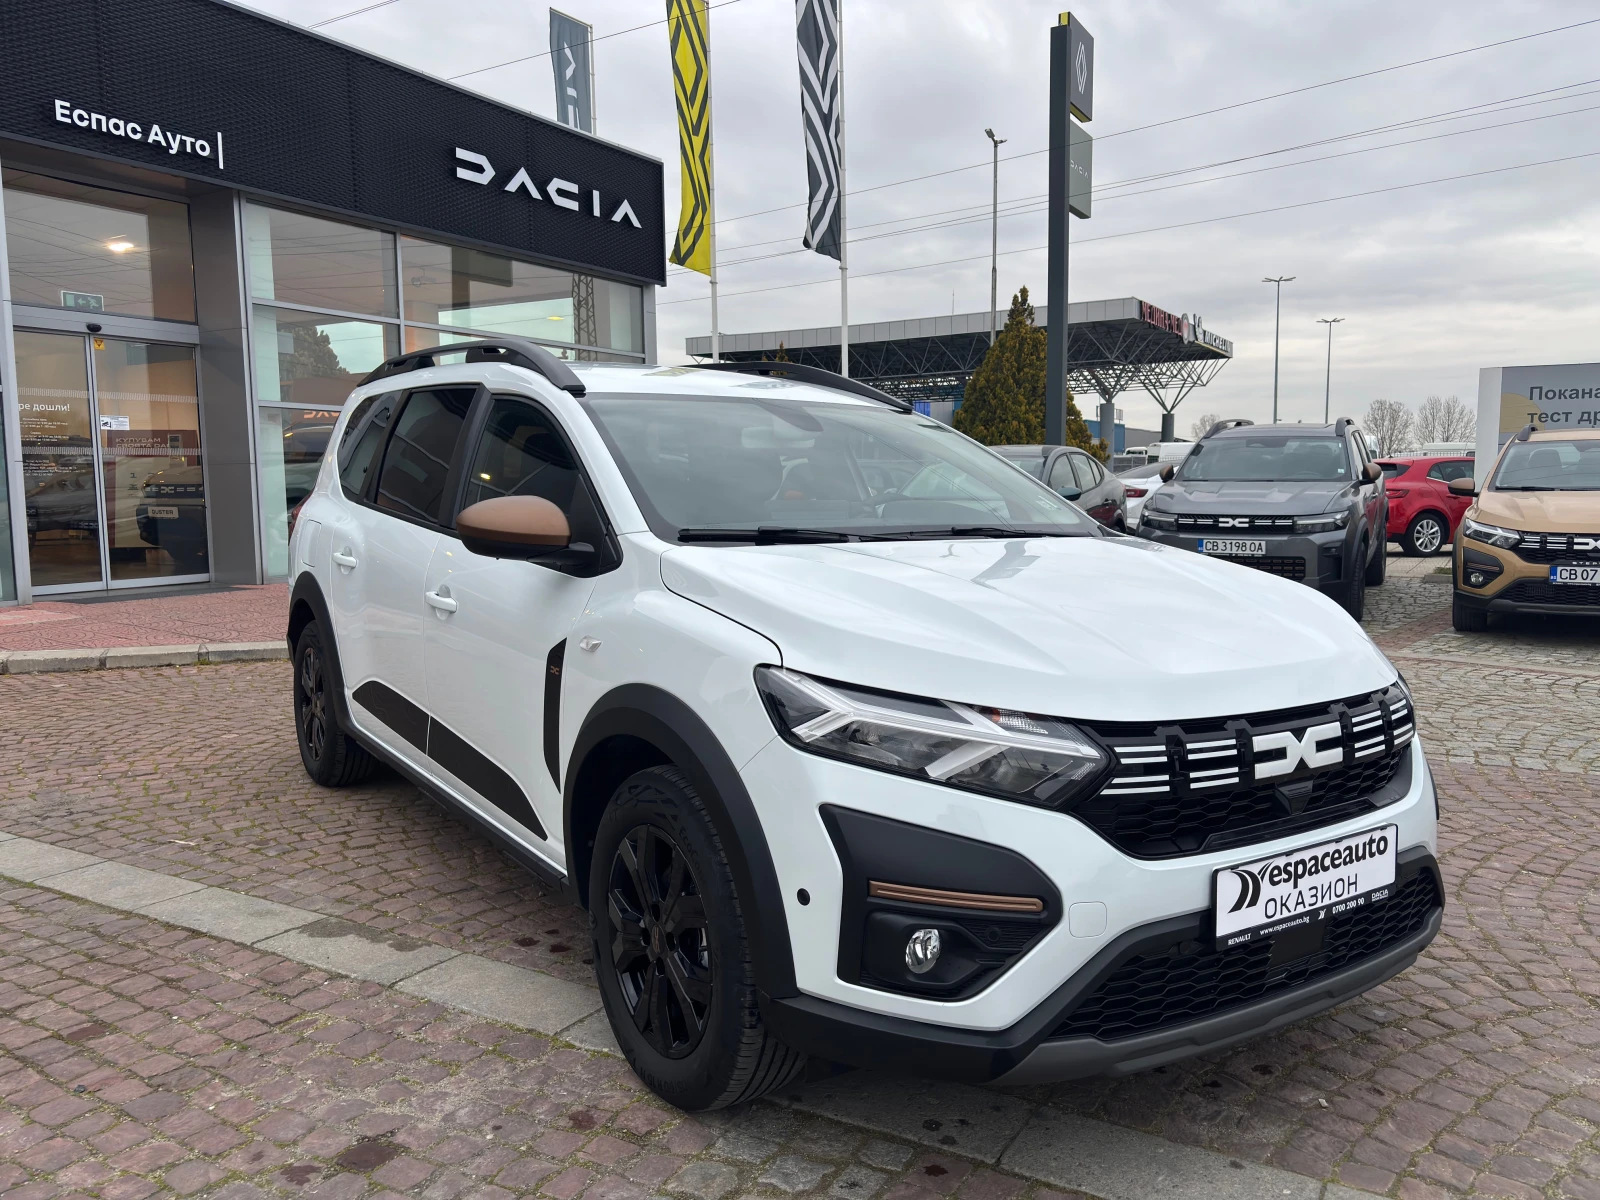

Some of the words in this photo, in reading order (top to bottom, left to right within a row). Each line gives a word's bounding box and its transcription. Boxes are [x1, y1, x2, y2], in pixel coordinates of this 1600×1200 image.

[54, 98, 143, 141] Еспас
[147, 123, 212, 157] Ауто
[1070, 159, 1089, 178] DACIA
[455, 146, 643, 229] DACIA
[33, 403, 70, 412] дошли!
[1527, 411, 1572, 423] тест
[1205, 541, 1219, 551] CB
[1220, 541, 1247, 552] 3198
[1559, 568, 1578, 580] CB
[1268, 835, 1388, 888] espaceauto
[1264, 873, 1358, 919] ОКАЗИОН
[1228, 933, 1251, 945] RENAULT
[1259, 916, 1309, 935] www.espaceauto.bg
[1332, 903, 1345, 914] 0700
[1346, 899, 1357, 910] 200
[1357, 897, 1365, 906] 90
